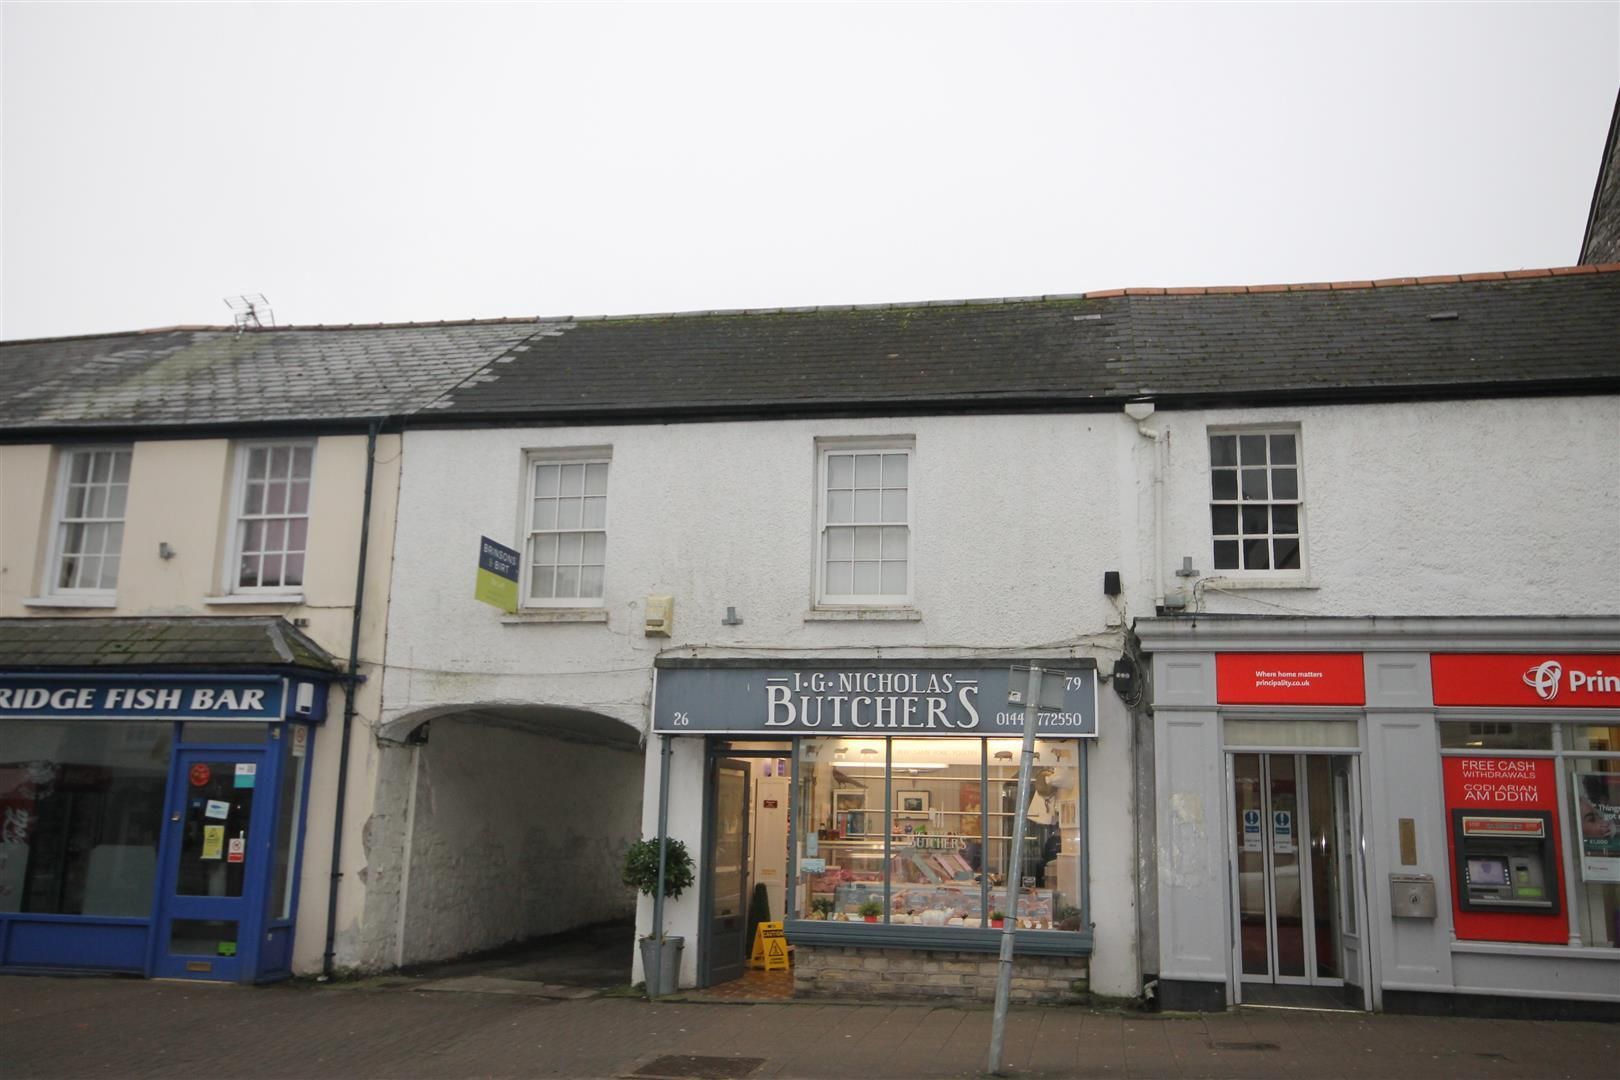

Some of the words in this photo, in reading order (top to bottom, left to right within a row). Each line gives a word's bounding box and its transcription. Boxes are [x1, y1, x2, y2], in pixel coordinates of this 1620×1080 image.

[1569, 670, 1620, 692] Prin
[104, 688, 183, 709] FISH
[190, 689, 265, 710] BAR
[764, 685, 980, 729] BUTCHERS
[673, 711, 689, 726] 26
[996, 712, 1027, 726] 0144
[1037, 712, 1083, 726] 772550
[1461, 760, 1495, 771] FREE
[1498, 761, 1536, 771] CASH
[1463, 771, 1537, 779] WITHDRAWALS
[1463, 783, 1495, 791] CODI
[1498, 784, 1537, 792] ARIAN
[1464, 791, 1490, 801] AM
[1494, 791, 1538, 802] DDIM
